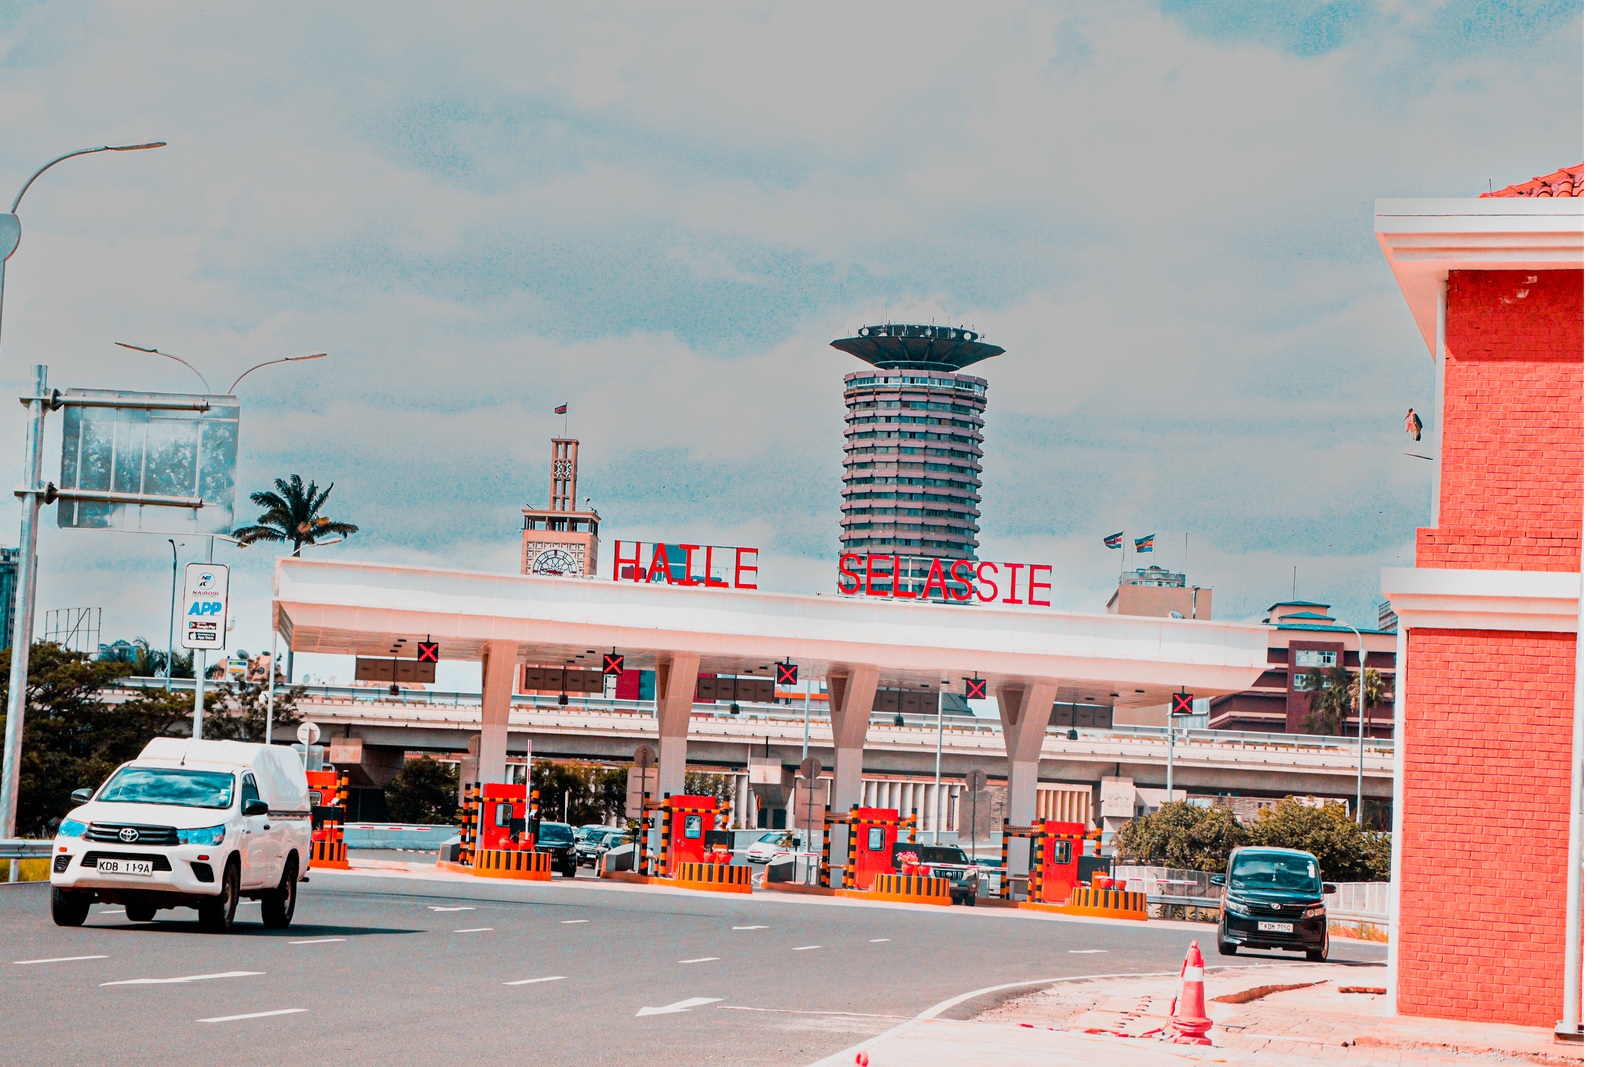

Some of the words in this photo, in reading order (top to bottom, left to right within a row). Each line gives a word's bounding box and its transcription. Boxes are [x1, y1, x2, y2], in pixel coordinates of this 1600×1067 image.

[614, 540, 758, 590] HAILE
[838, 552, 1052, 607] SELASSIE
[188, 601, 222, 616] APP
[99, 861, 119, 872] KDB
